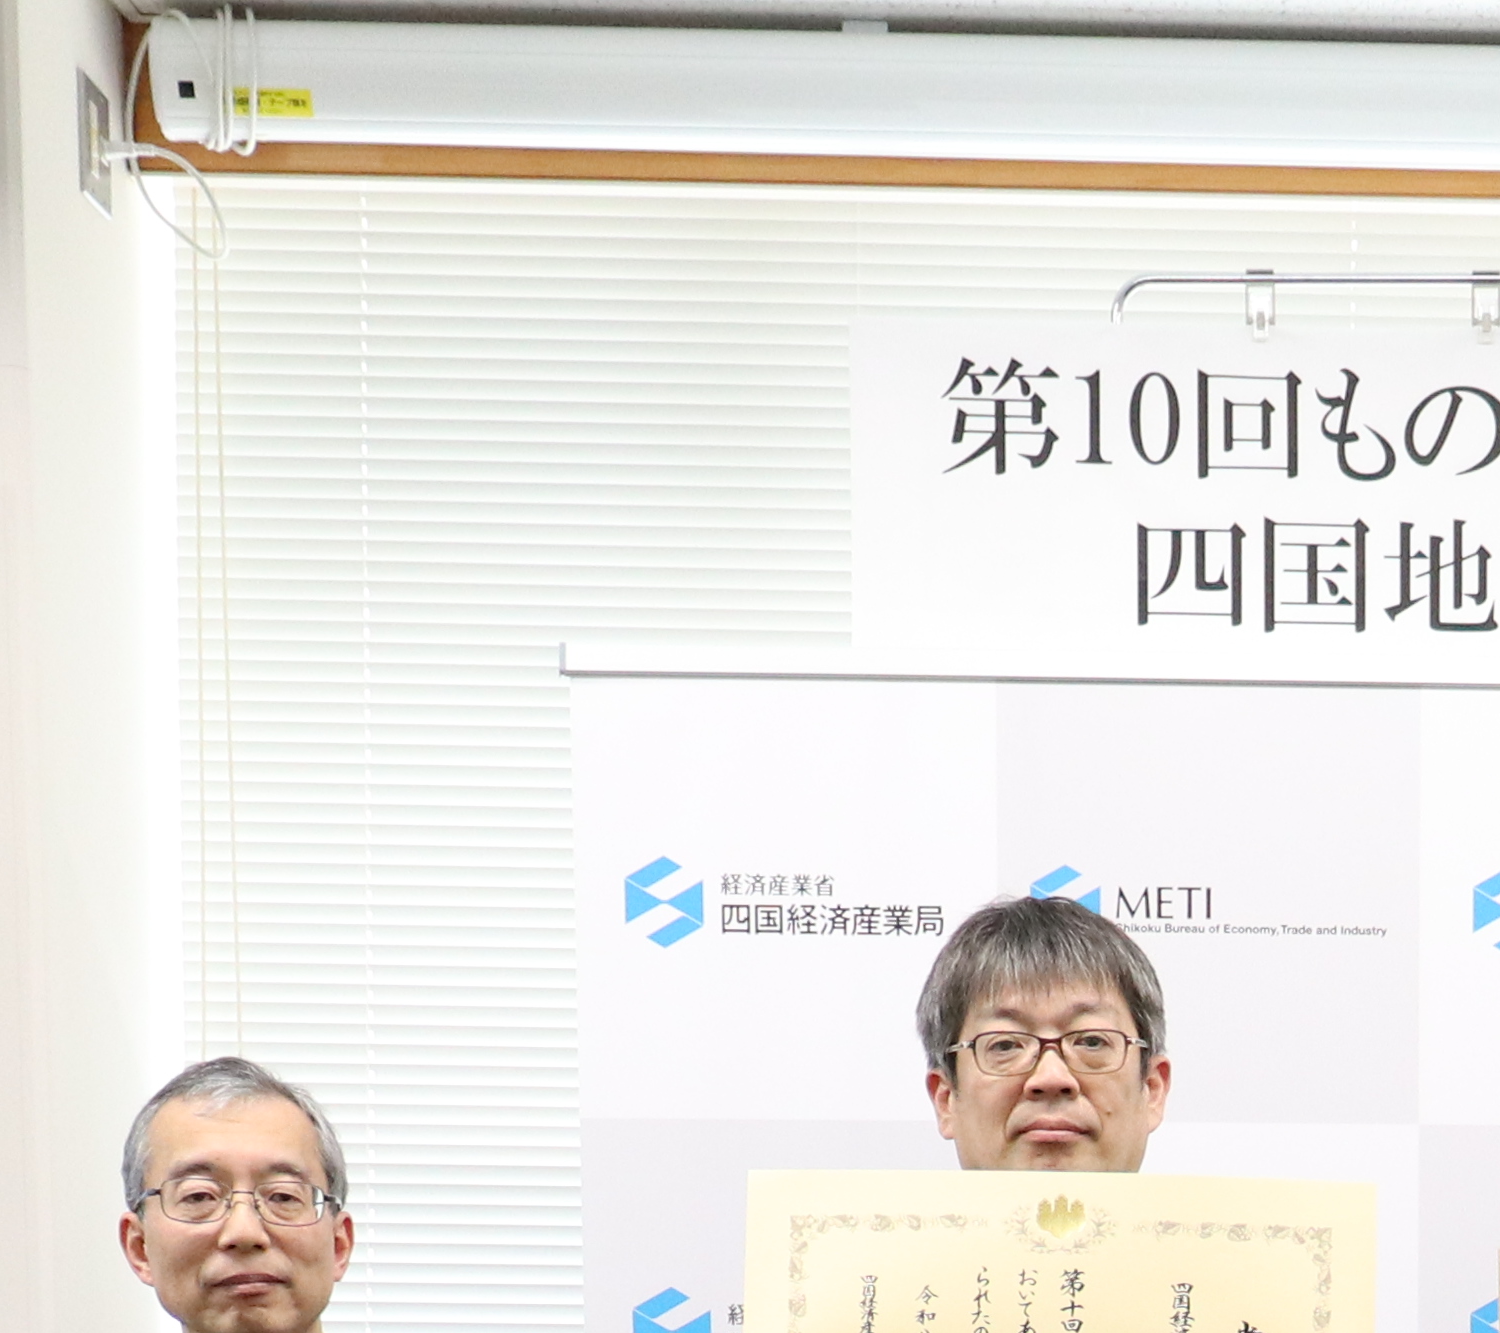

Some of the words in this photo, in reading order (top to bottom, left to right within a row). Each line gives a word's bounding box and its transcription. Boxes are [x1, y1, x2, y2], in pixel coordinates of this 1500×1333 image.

[721, 874, 833, 896] 経済産業省
[1116, 886, 1212, 920] METI
[721, 904, 944, 937] 四国経済産業局
[1164, 922, 1206, 934] Bureau
[1208, 924, 1220, 934] of
[1223, 923, 1279, 936] Economy,
[1280, 924, 1313, 935] Trade
[1316, 925, 1338, 935] and
[1340, 925, 1387, 937] Industry
